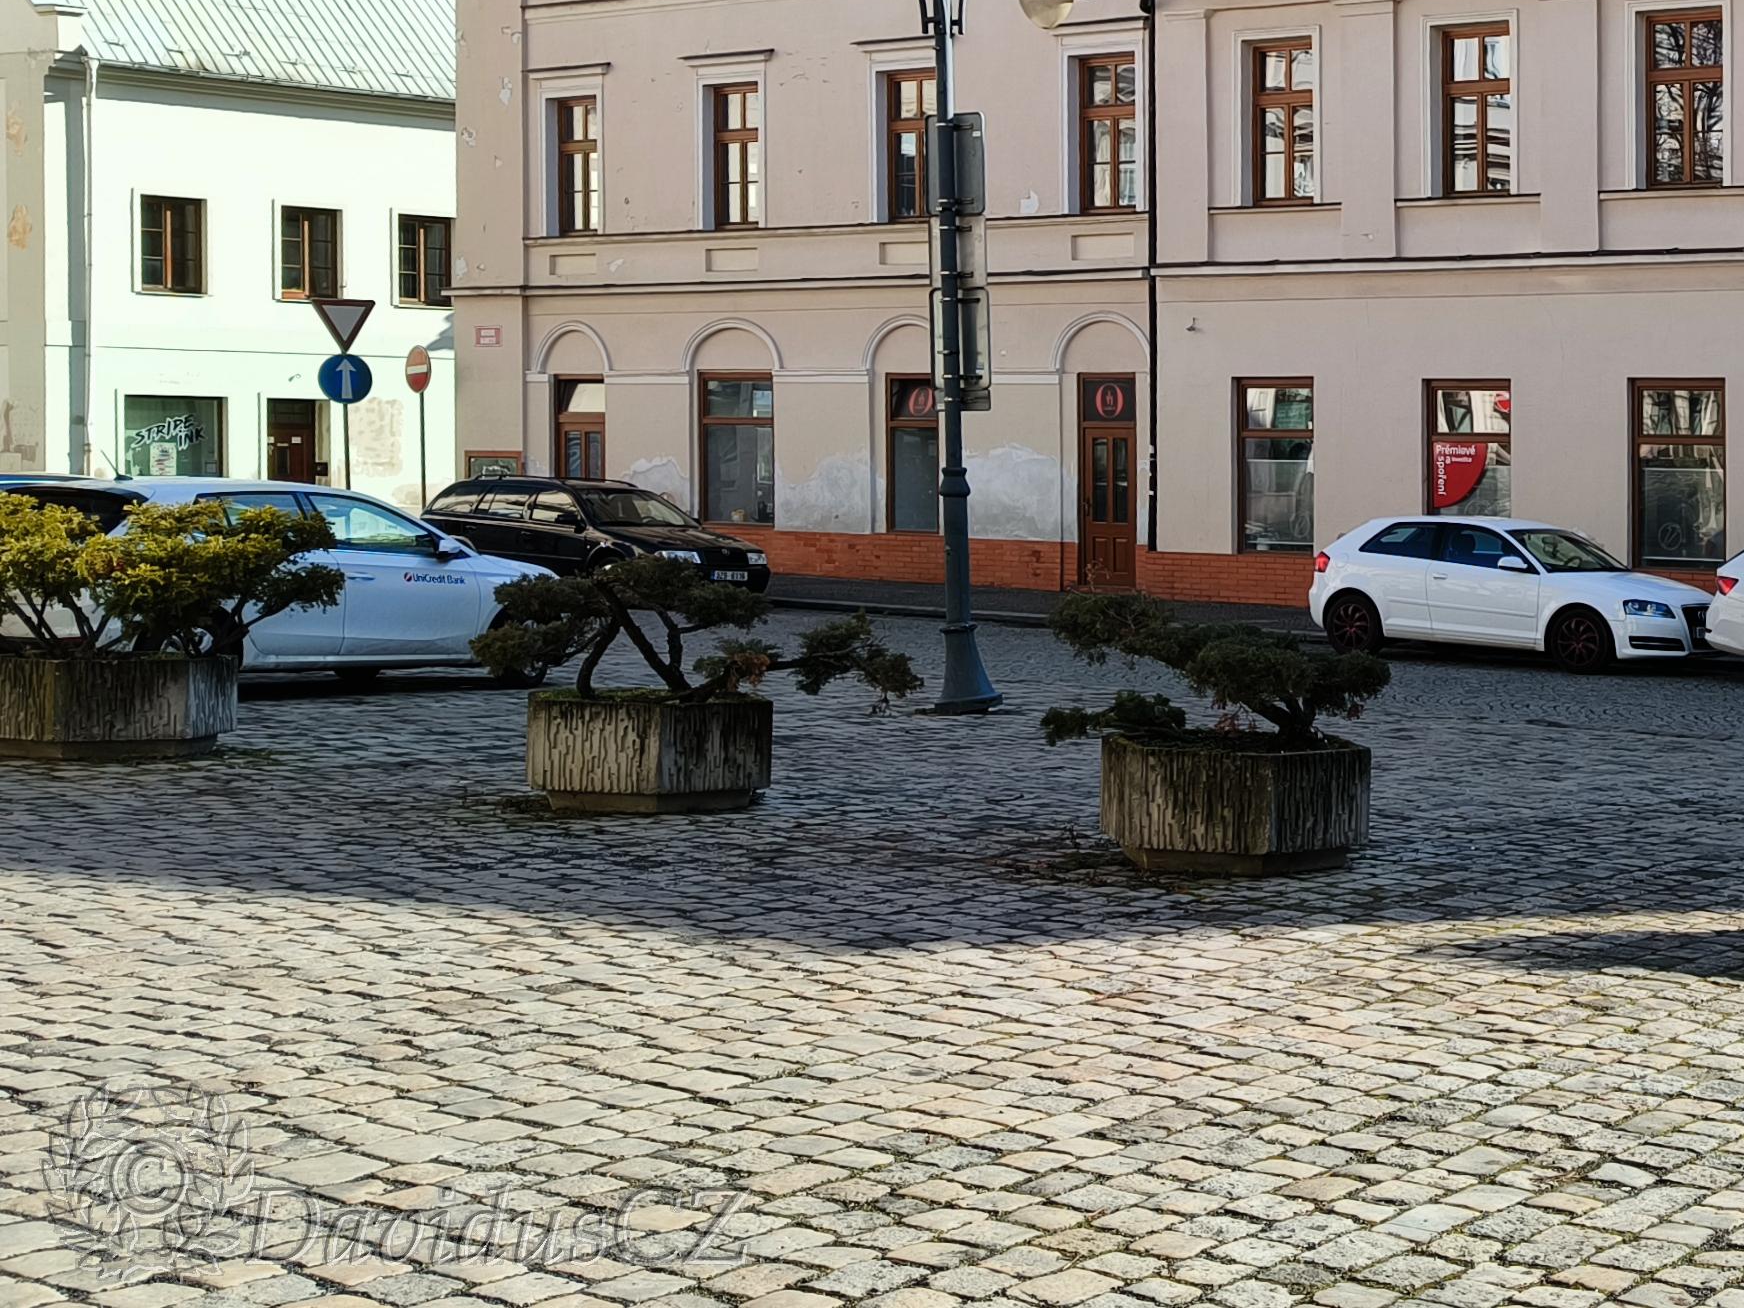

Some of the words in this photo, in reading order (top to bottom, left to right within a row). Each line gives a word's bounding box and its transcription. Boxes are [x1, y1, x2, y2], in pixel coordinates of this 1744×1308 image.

[131, 413, 194, 448] STRIPE
[178, 424, 208, 451] INK
[1436, 444, 1476, 456] Prémiové
[1436, 455, 1447, 496] spoření
[412, 572, 446, 584] UniCredit
[446, 574, 466, 585] Bank
